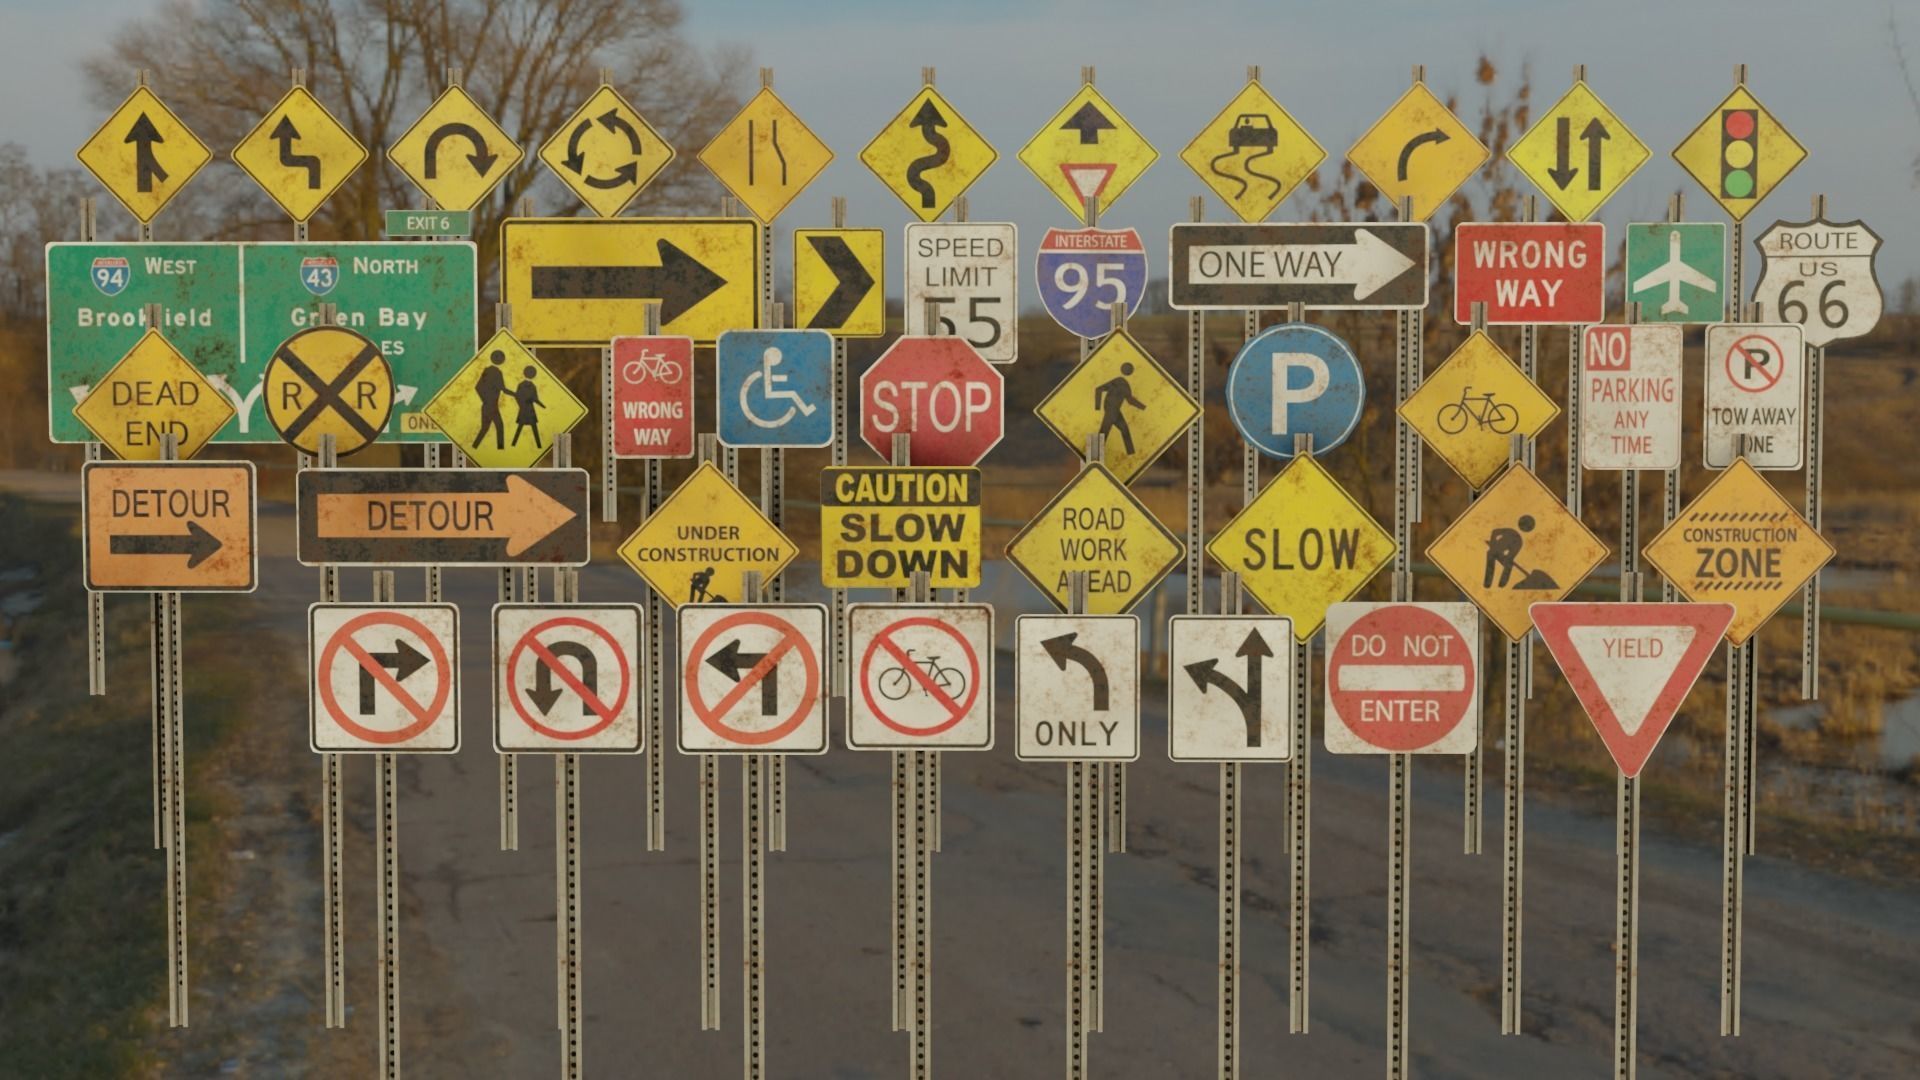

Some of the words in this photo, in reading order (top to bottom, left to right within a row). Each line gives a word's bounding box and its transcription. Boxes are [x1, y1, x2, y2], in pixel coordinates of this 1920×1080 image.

[407, 217, 437, 231] EXIT
[440, 217, 450, 231] 6
[918, 238, 1004, 257] SPEED
[1055, 234, 1129, 249] INTERSTATE
[1780, 232, 1859, 250] ROUTE
[1198, 251, 1266, 279] ONE
[1273, 251, 1343, 279] WAY
[1473, 240, 1588, 269] WRONG
[97, 268, 124, 288] 94
[306, 267, 333, 287] 43
[926, 267, 998, 287] LIMIT
[1800, 262, 1838, 277] US
[1054, 262, 1128, 311] 95
[1495, 279, 1564, 308] WAY
[1778, 280, 1849, 329] 66
[78, 308, 212, 327] Brookield
[290, 307, 366, 327] Gren
[378, 307, 428, 331] Bay
[1589, 333, 1627, 367] NO
[112, 381, 200, 406] DEAD
[282, 382, 301, 410] R
[357, 382, 377, 410] R
[1271, 352, 1331, 436] P
[1592, 377, 1675, 403] PARKING
[622, 401, 684, 420] WRONG
[872, 381, 992, 433] STOP
[1712, 407, 1749, 425] TOW
[1751, 407, 1797, 425] AWAY
[408, 415, 438, 430] ONL
[1614, 411, 1649, 429] ANY
[126, 421, 189, 446] END
[634, 428, 672, 446] WAY
[1611, 436, 1653, 454] TIME
[835, 473, 968, 503] CAUTION
[112, 489, 230, 518] DETOUR
[368, 501, 494, 532] DETOUR
[840, 513, 966, 542] SLOW
[1063, 507, 1125, 530] ROAD
[677, 525, 740, 542] UNDER
[1683, 527, 1798, 543] CONSTRUCTION
[637, 545, 780, 563] CONSTRUCTION
[1060, 538, 1127, 561] WORK
[1242, 527, 1361, 571] SLOW
[837, 549, 968, 578] DOWN
[1695, 548, 1782, 578] ZONE
[1056, 570, 1132, 593] AEAD
[1351, 634, 1387, 657] DO
[1403, 634, 1454, 657] NOT
[1602, 637, 1664, 659] YIELD
[1360, 699, 1441, 723] ENTER
[1035, 720, 1120, 747] ONLY
